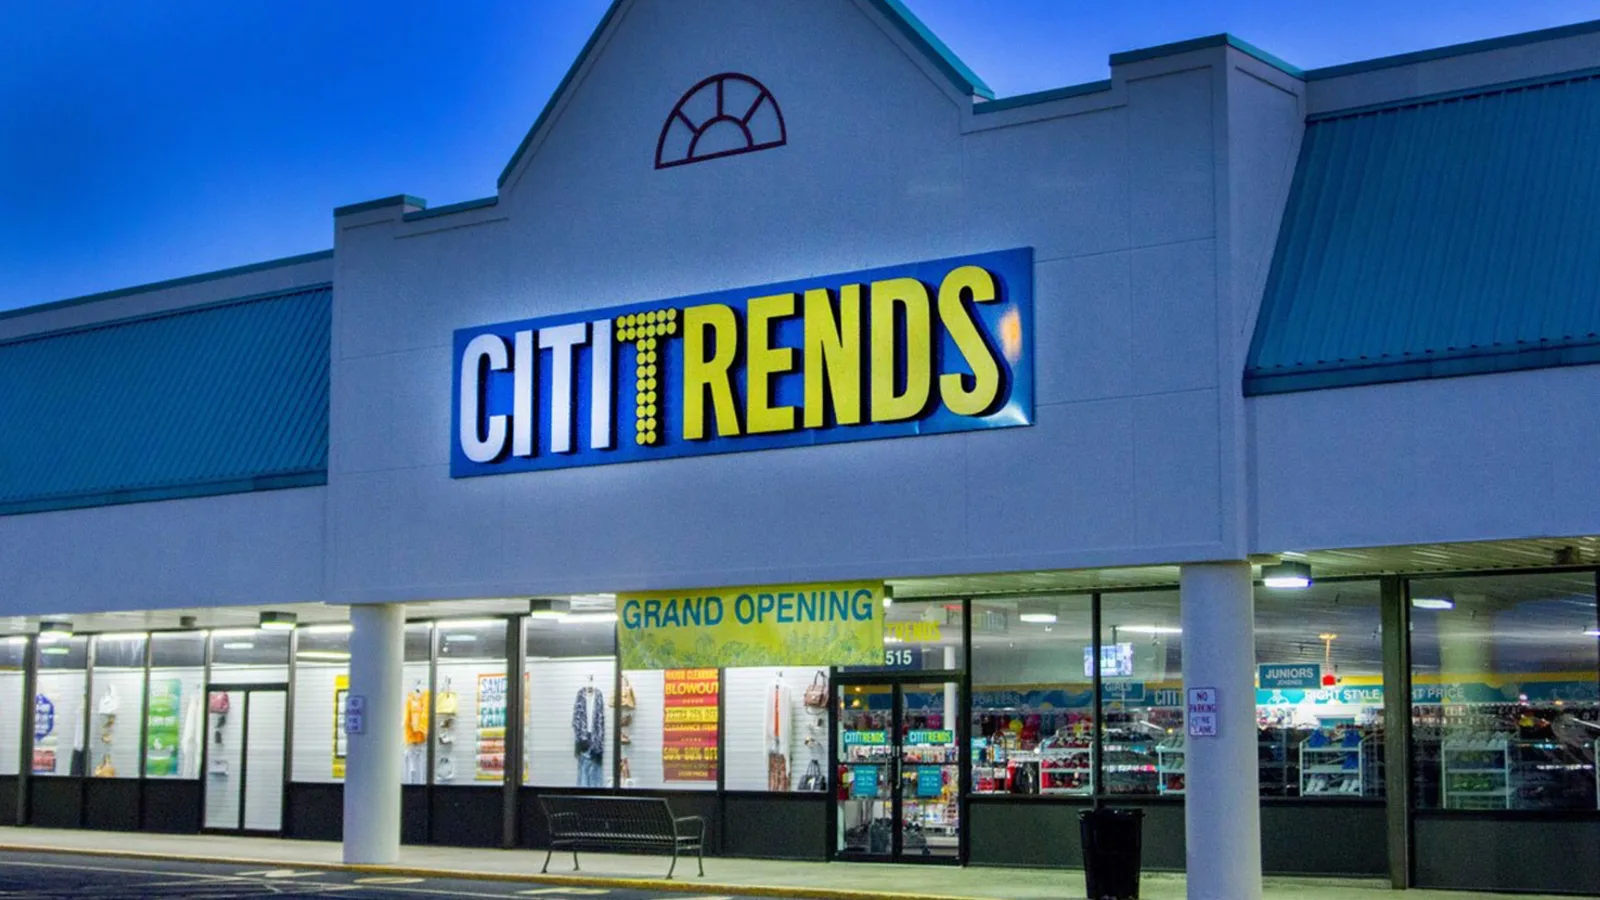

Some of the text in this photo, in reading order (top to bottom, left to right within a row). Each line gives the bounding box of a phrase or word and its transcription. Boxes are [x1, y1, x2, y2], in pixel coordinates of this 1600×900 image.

[622, 588, 874, 630] GRAND OPENING
[885, 649, 912, 666] 515
[1265, 668, 1315, 679] JUNIORS
[665, 682, 719, 695] BLOWOUT
[1344, 688, 1380, 700] STYLE
[1427, 687, 1465, 699] PRICE
[1196, 691, 1208, 702] NO
